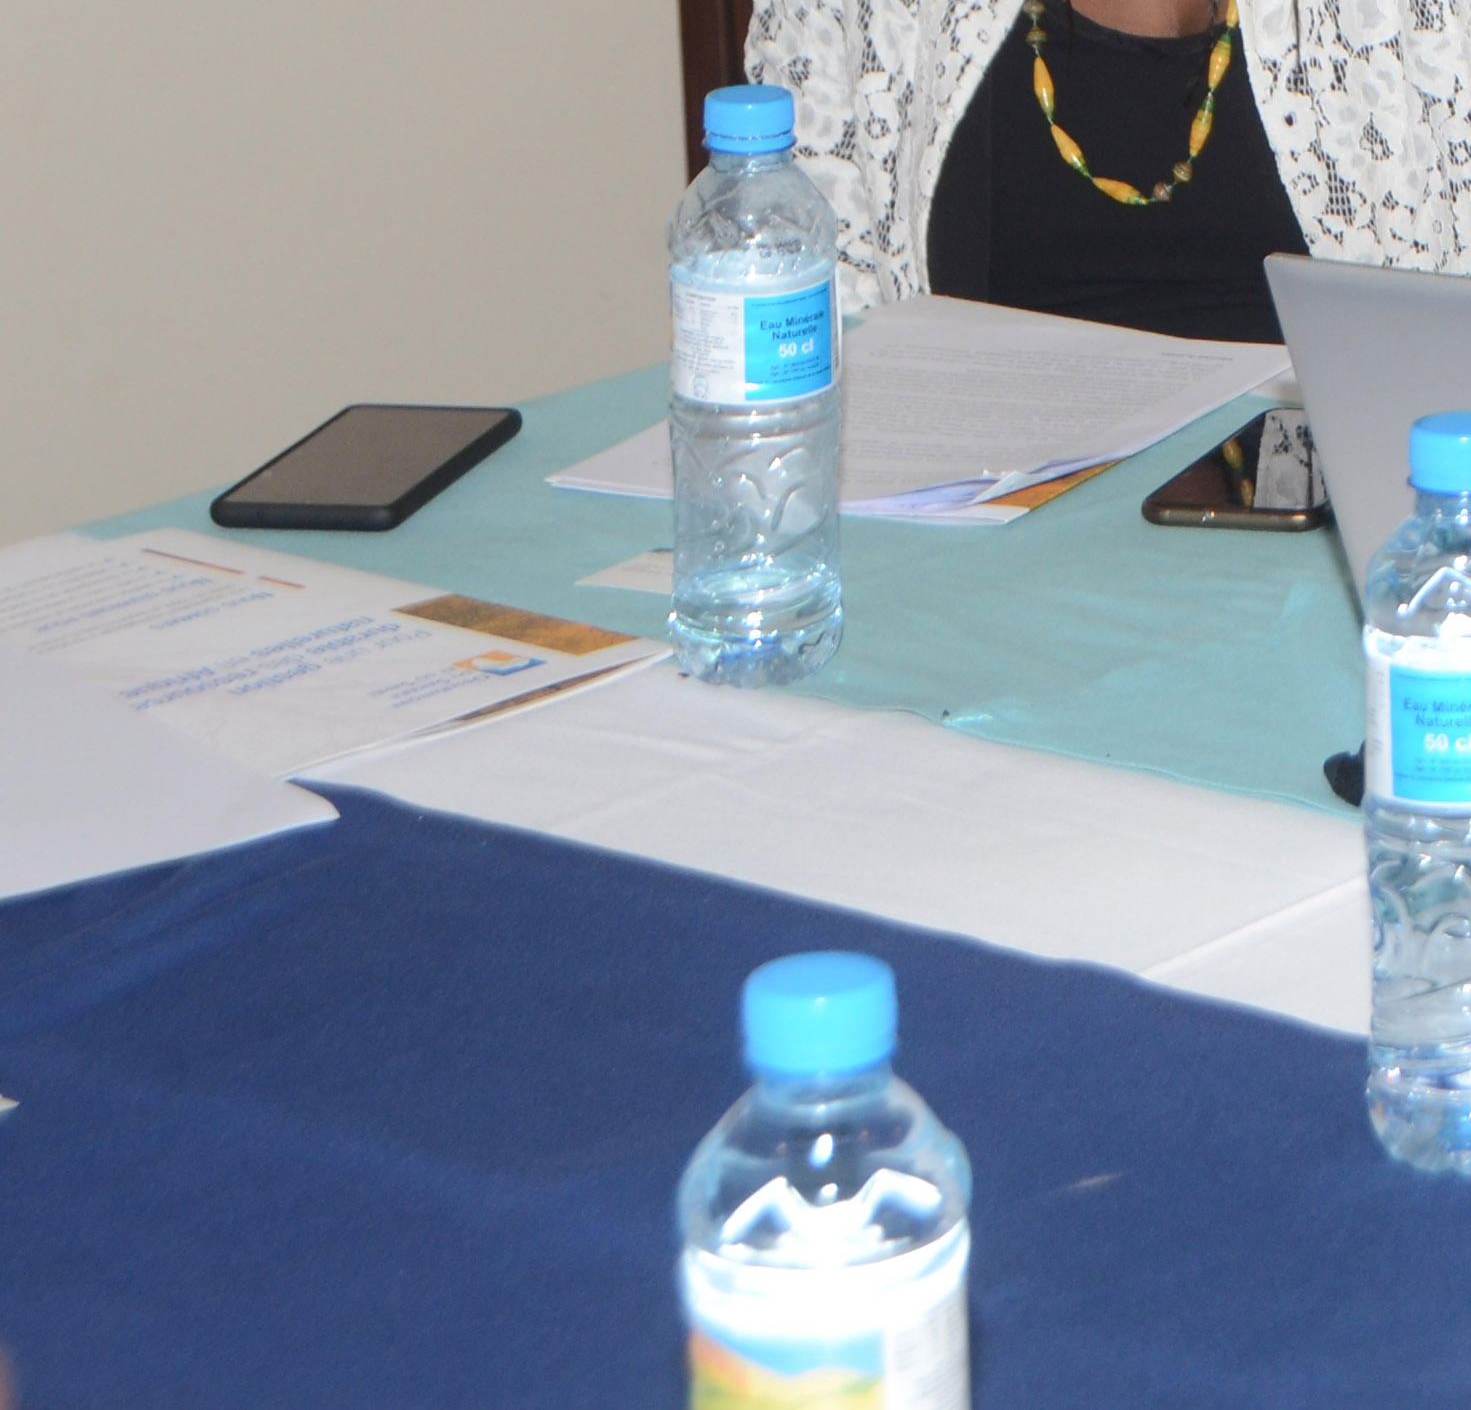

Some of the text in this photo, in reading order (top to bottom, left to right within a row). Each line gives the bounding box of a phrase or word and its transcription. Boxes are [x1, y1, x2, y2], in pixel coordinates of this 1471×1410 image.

[760, 311, 825, 331] Eau Minérale
[772, 325, 818, 341] Naturelle
[778, 338, 814, 358] 50 cl
[1403, 697, 1427, 711] Eau
[1424, 733, 1449, 751] 50
